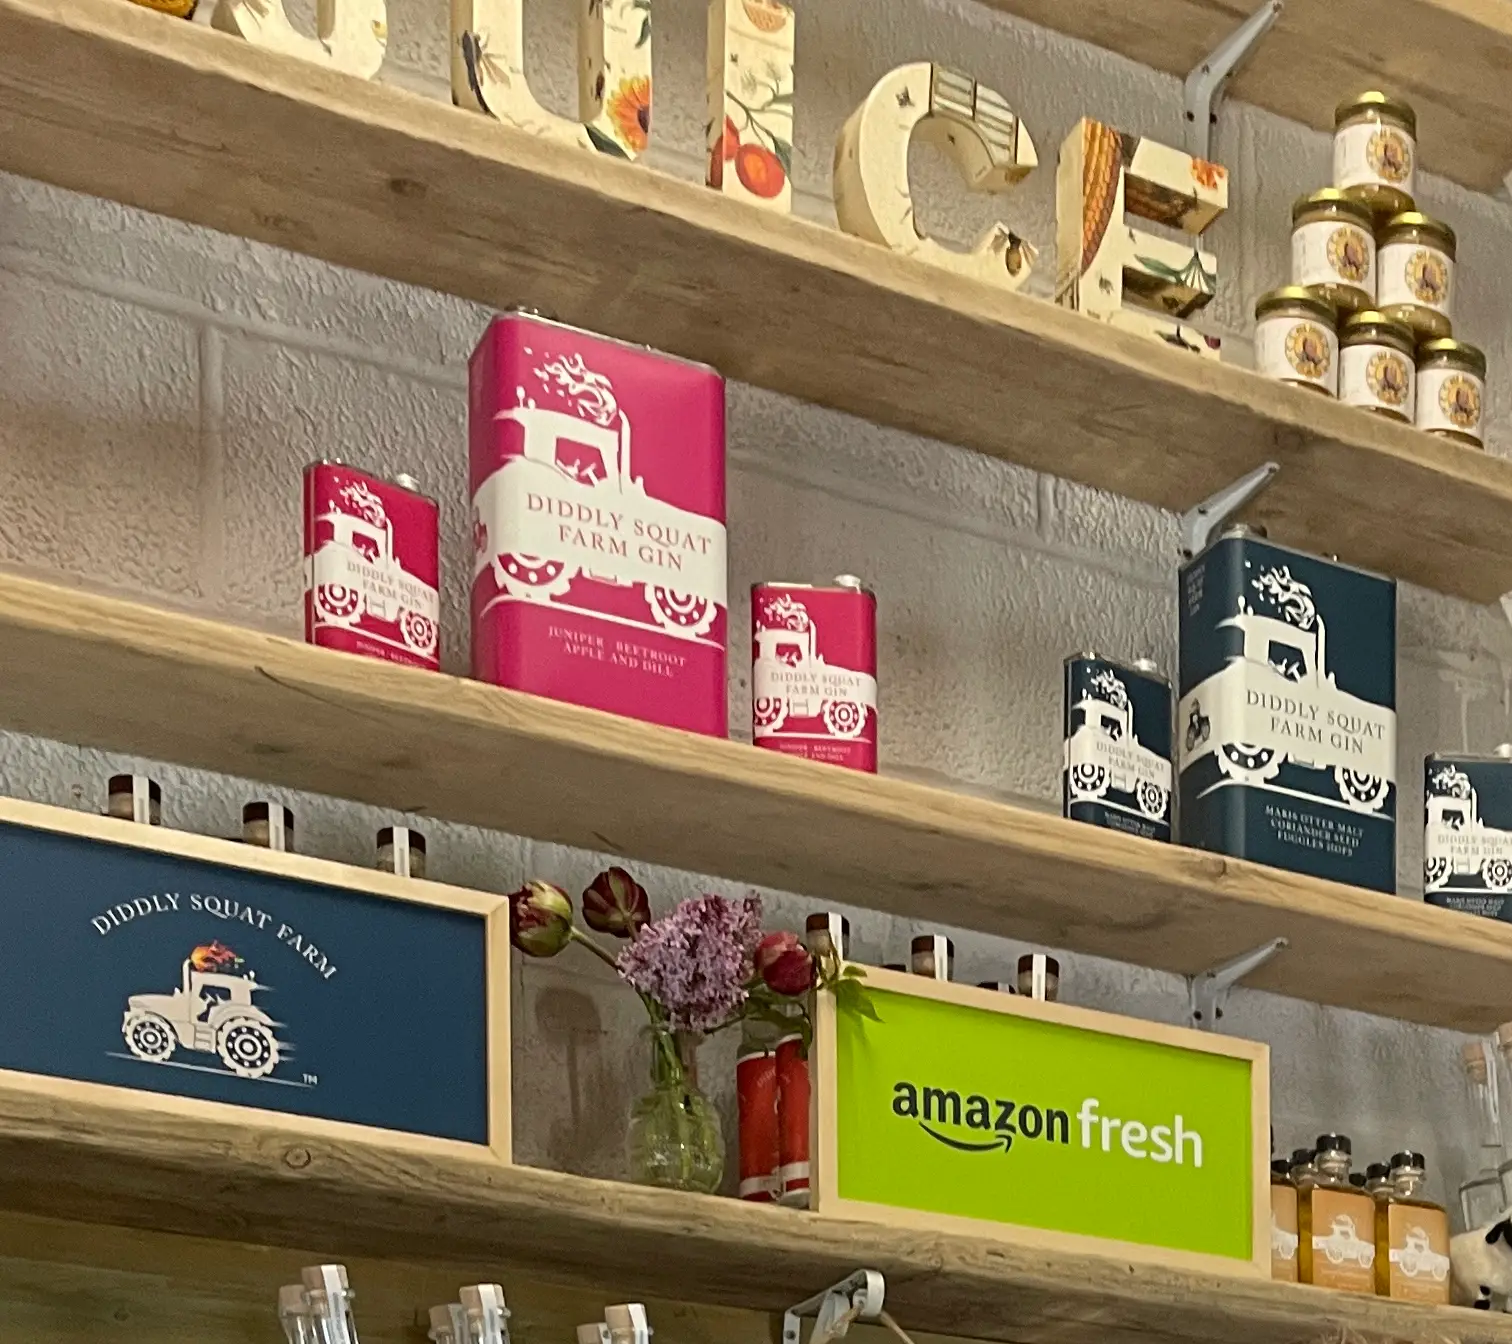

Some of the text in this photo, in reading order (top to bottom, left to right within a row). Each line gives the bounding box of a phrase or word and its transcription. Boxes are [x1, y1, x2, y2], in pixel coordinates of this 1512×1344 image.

[526, 492, 712, 556] DIDDLY SQUAT
[557, 523, 685, 573] FARM GIN
[547, 625, 687, 667] JUNIPER BEETROOT
[562, 640, 675, 679] APPLE AND DILL
[1246, 689, 1386, 742] DIDDLY SQUAT
[1269, 716, 1365, 756] FARM GIN
[1264, 803, 1297, 823] MARIS
[1332, 817, 1365, 839] MALT
[90, 891, 339, 982] DIDDLY SQUAT FARM
[891, 1081, 1203, 1169] amazon fresh
